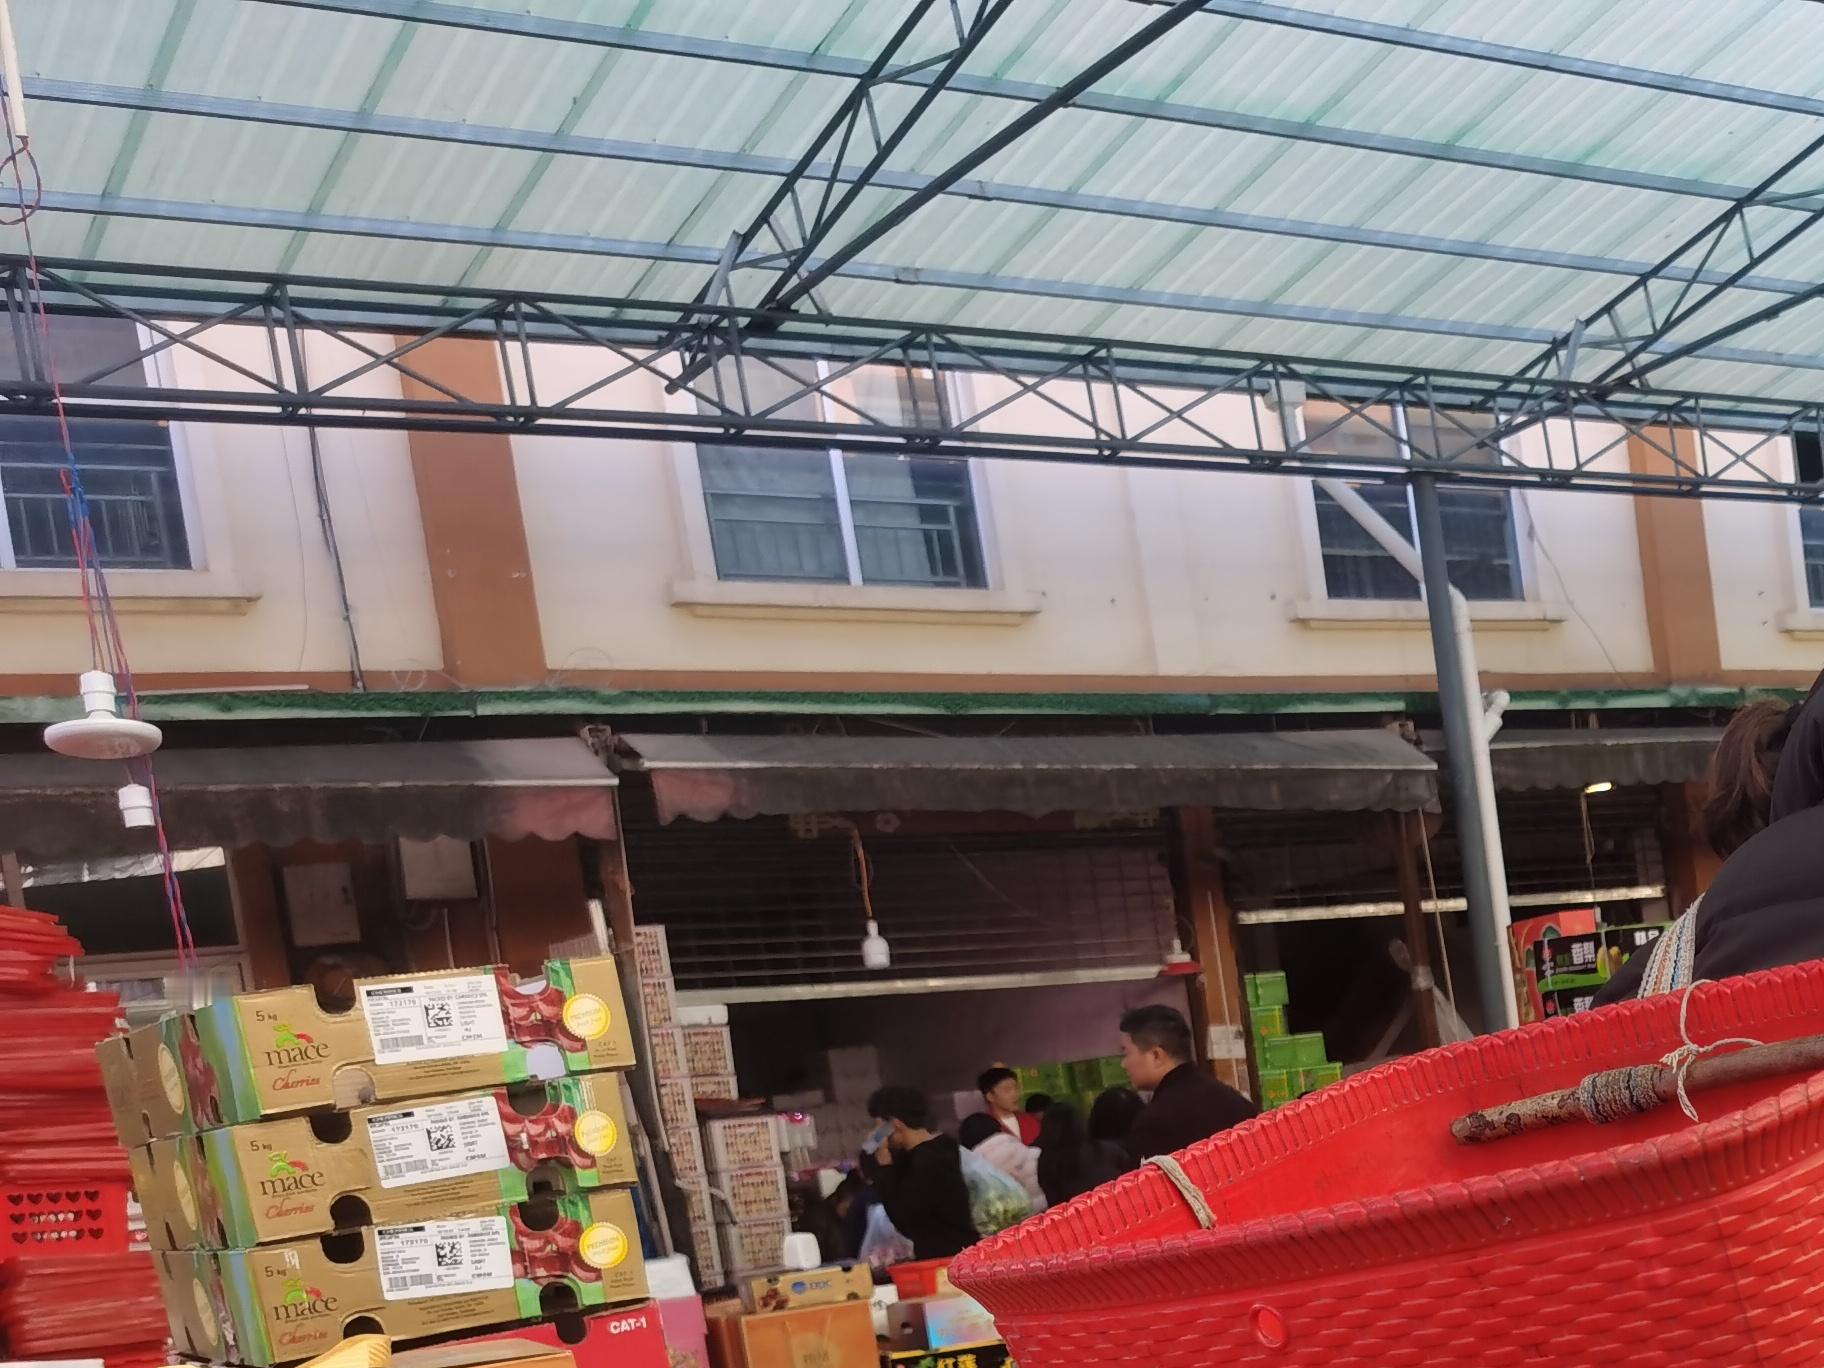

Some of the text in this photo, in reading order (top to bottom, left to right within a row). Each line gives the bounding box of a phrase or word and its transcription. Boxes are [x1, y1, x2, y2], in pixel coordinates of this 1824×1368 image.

[256, 1010, 265, 1021] 5
[264, 1043, 329, 1066] mace
[272, 1068, 320, 1091] Cherries
[250, 1140, 260, 1151] 5
[259, 1171, 326, 1196] mace
[265, 1197, 315, 1220] Cherries
[264, 1266, 274, 1277] 5
[273, 1296, 338, 1321] mace
[610, 1316, 647, 1334] CAT-1
